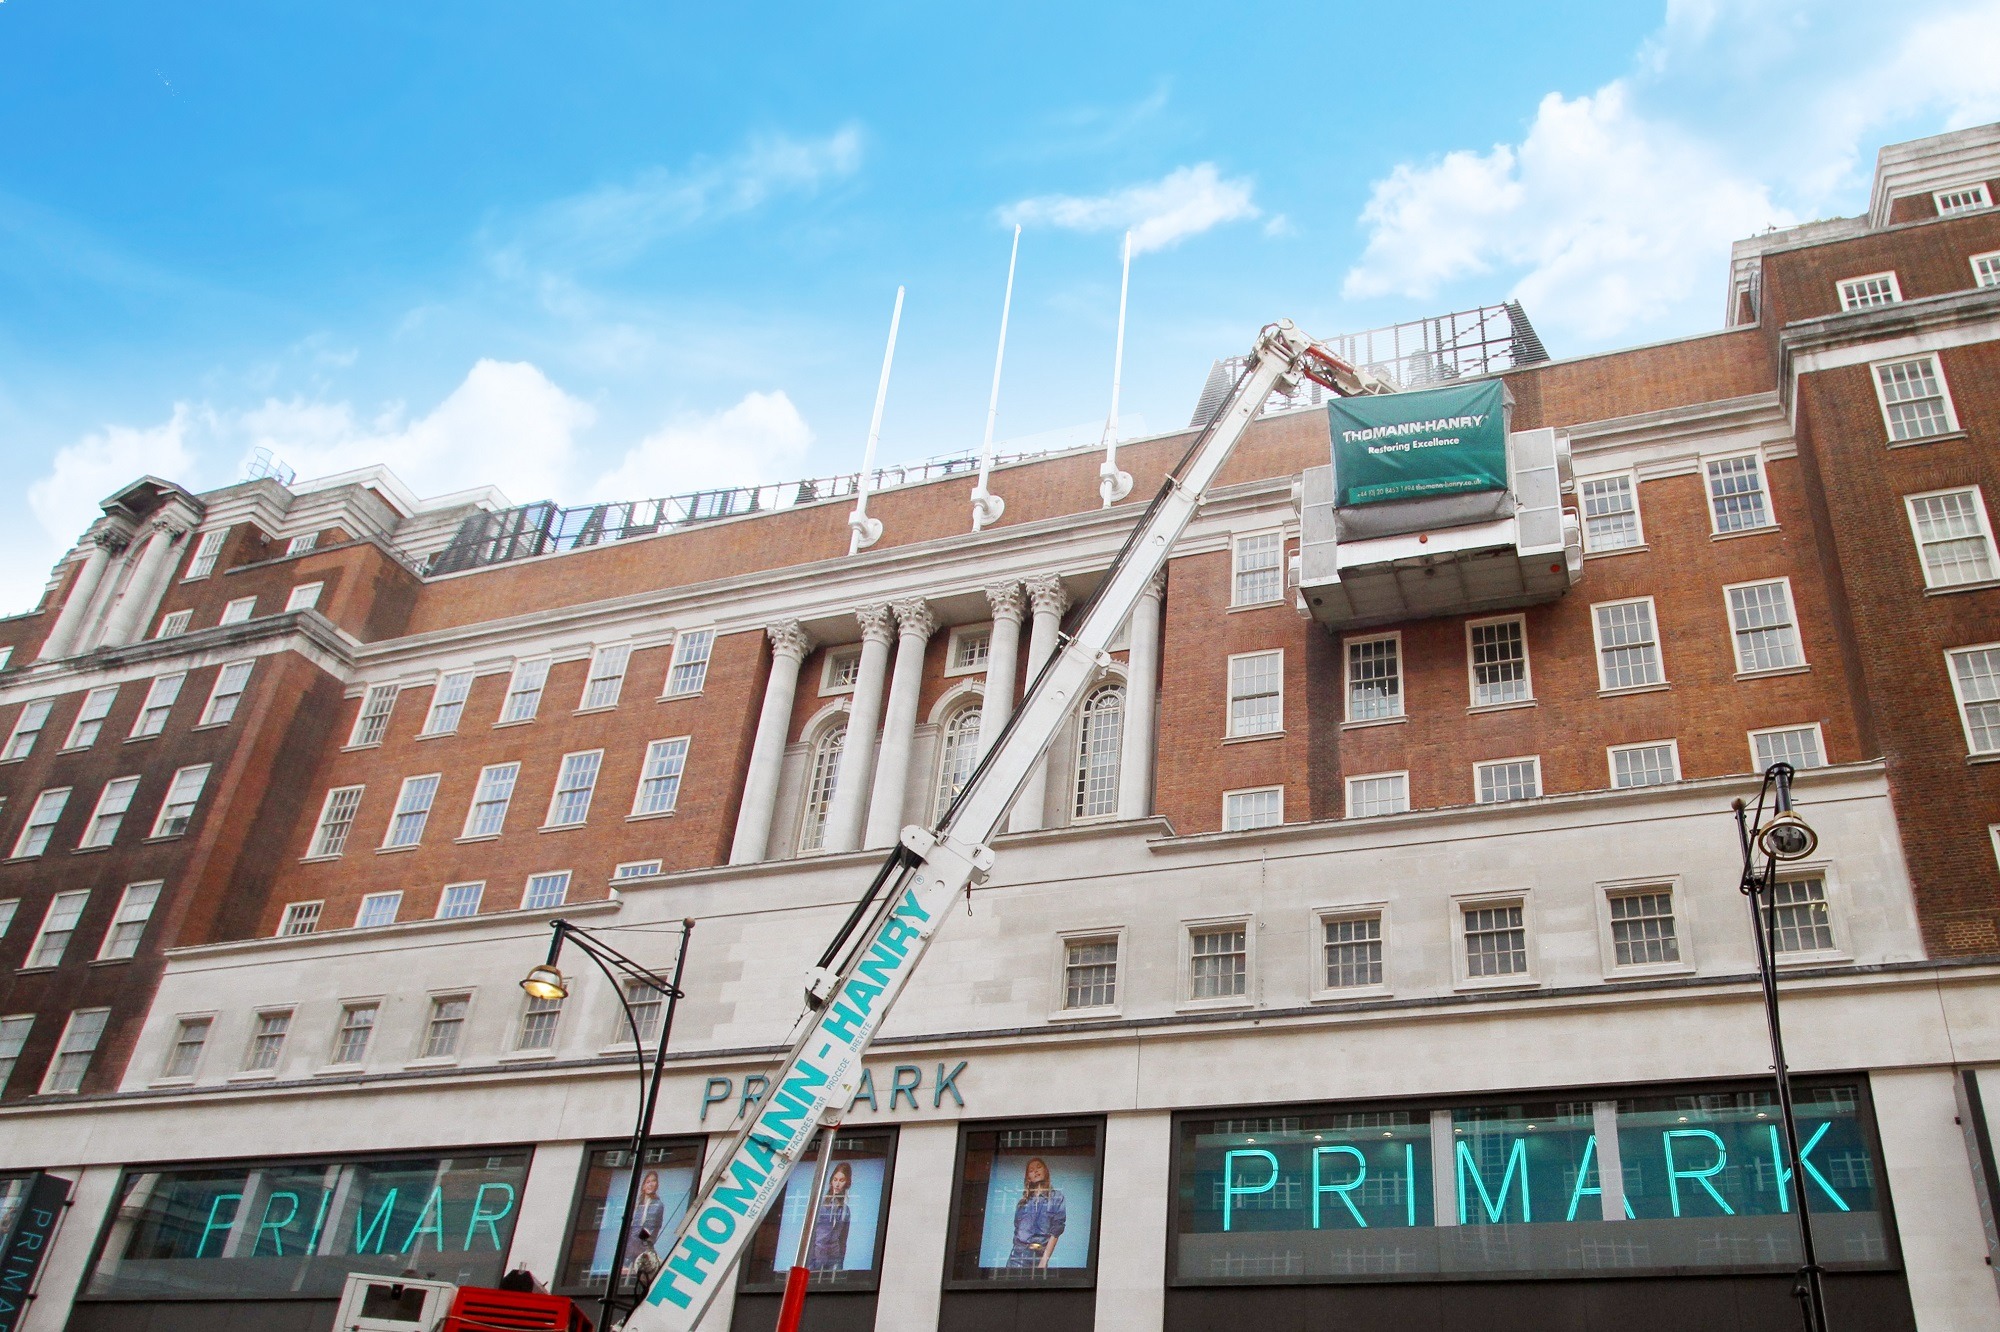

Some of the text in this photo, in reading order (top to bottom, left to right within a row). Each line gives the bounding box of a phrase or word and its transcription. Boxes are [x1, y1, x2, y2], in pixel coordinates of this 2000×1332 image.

[1342, 414, 1484, 443] THOMANN-HANRY
[1368, 436, 1460, 455] Restoring Excellence
[700, 1061, 968, 1121] PRARK
[747, 1175, 777, 1219] NETTOYAGE
[814, 1096, 826, 1111] PAR
[826, 1057, 850, 1091] PROCEDE
[850, 1022, 873, 1053] BREVETE
[1224, 1121, 1850, 1232] PRIMARK
